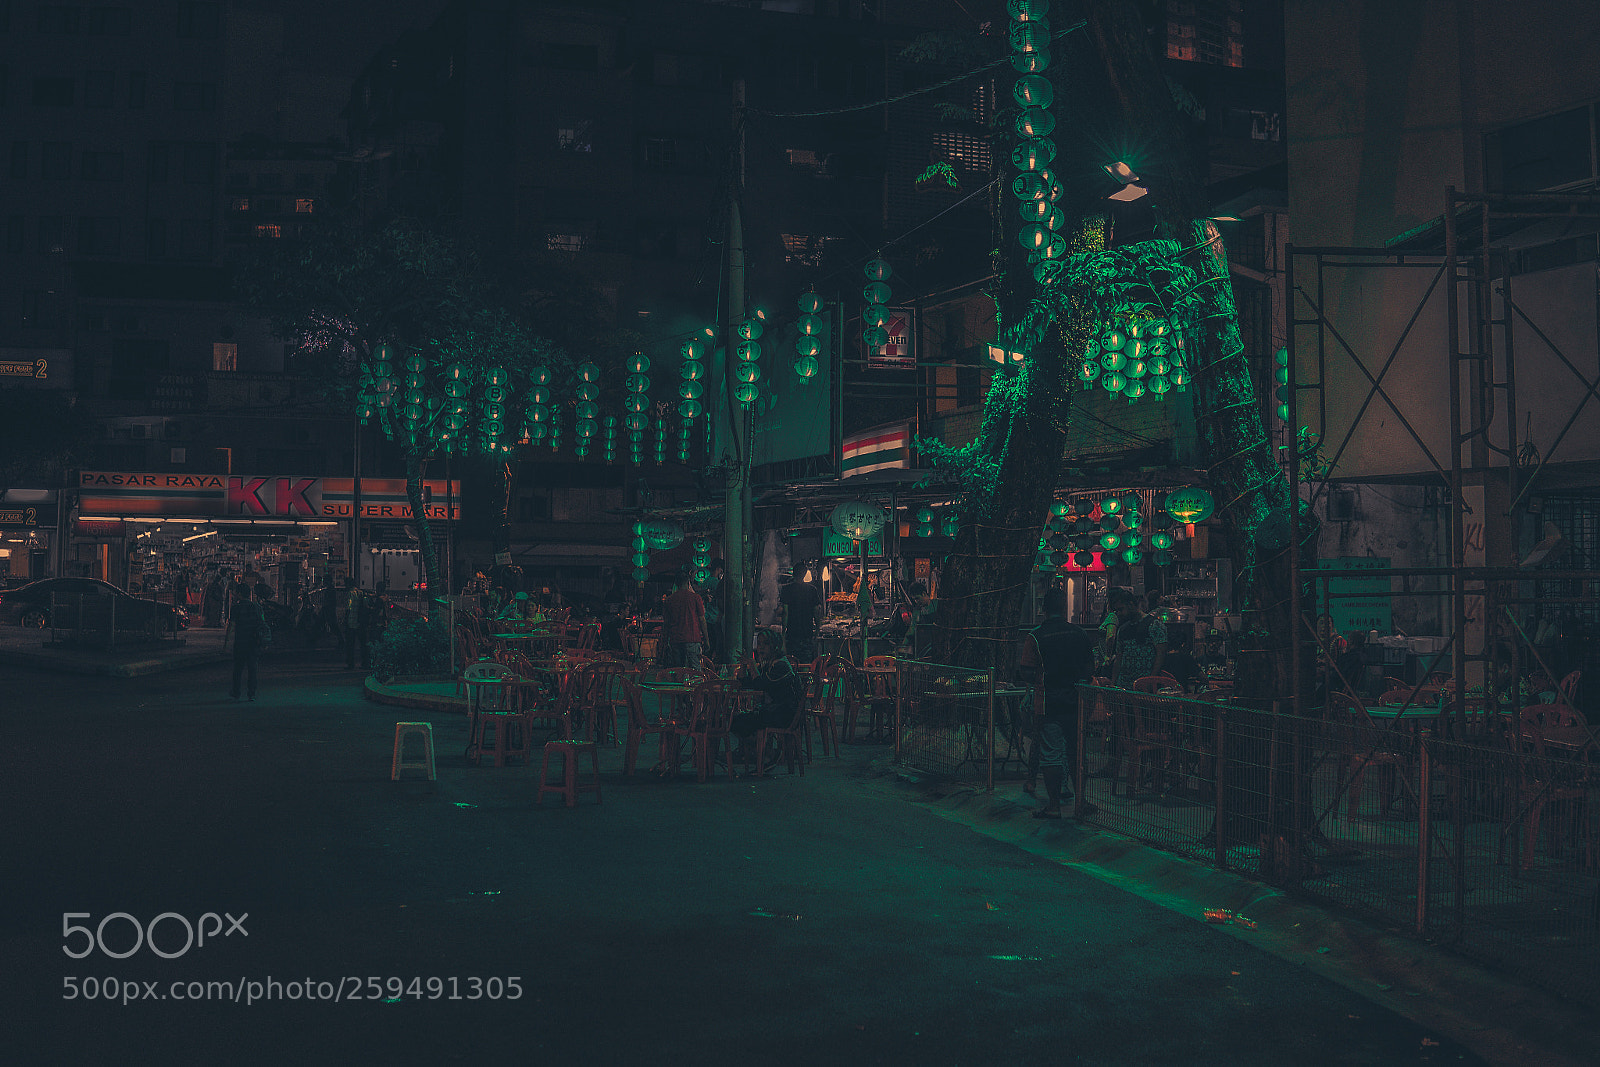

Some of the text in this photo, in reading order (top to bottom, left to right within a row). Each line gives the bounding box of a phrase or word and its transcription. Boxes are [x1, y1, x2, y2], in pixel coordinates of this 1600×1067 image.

[36, 358, 48, 379] 2
[82, 474, 223, 488] PASAR RAYA
[26, 507, 36, 526] 2
